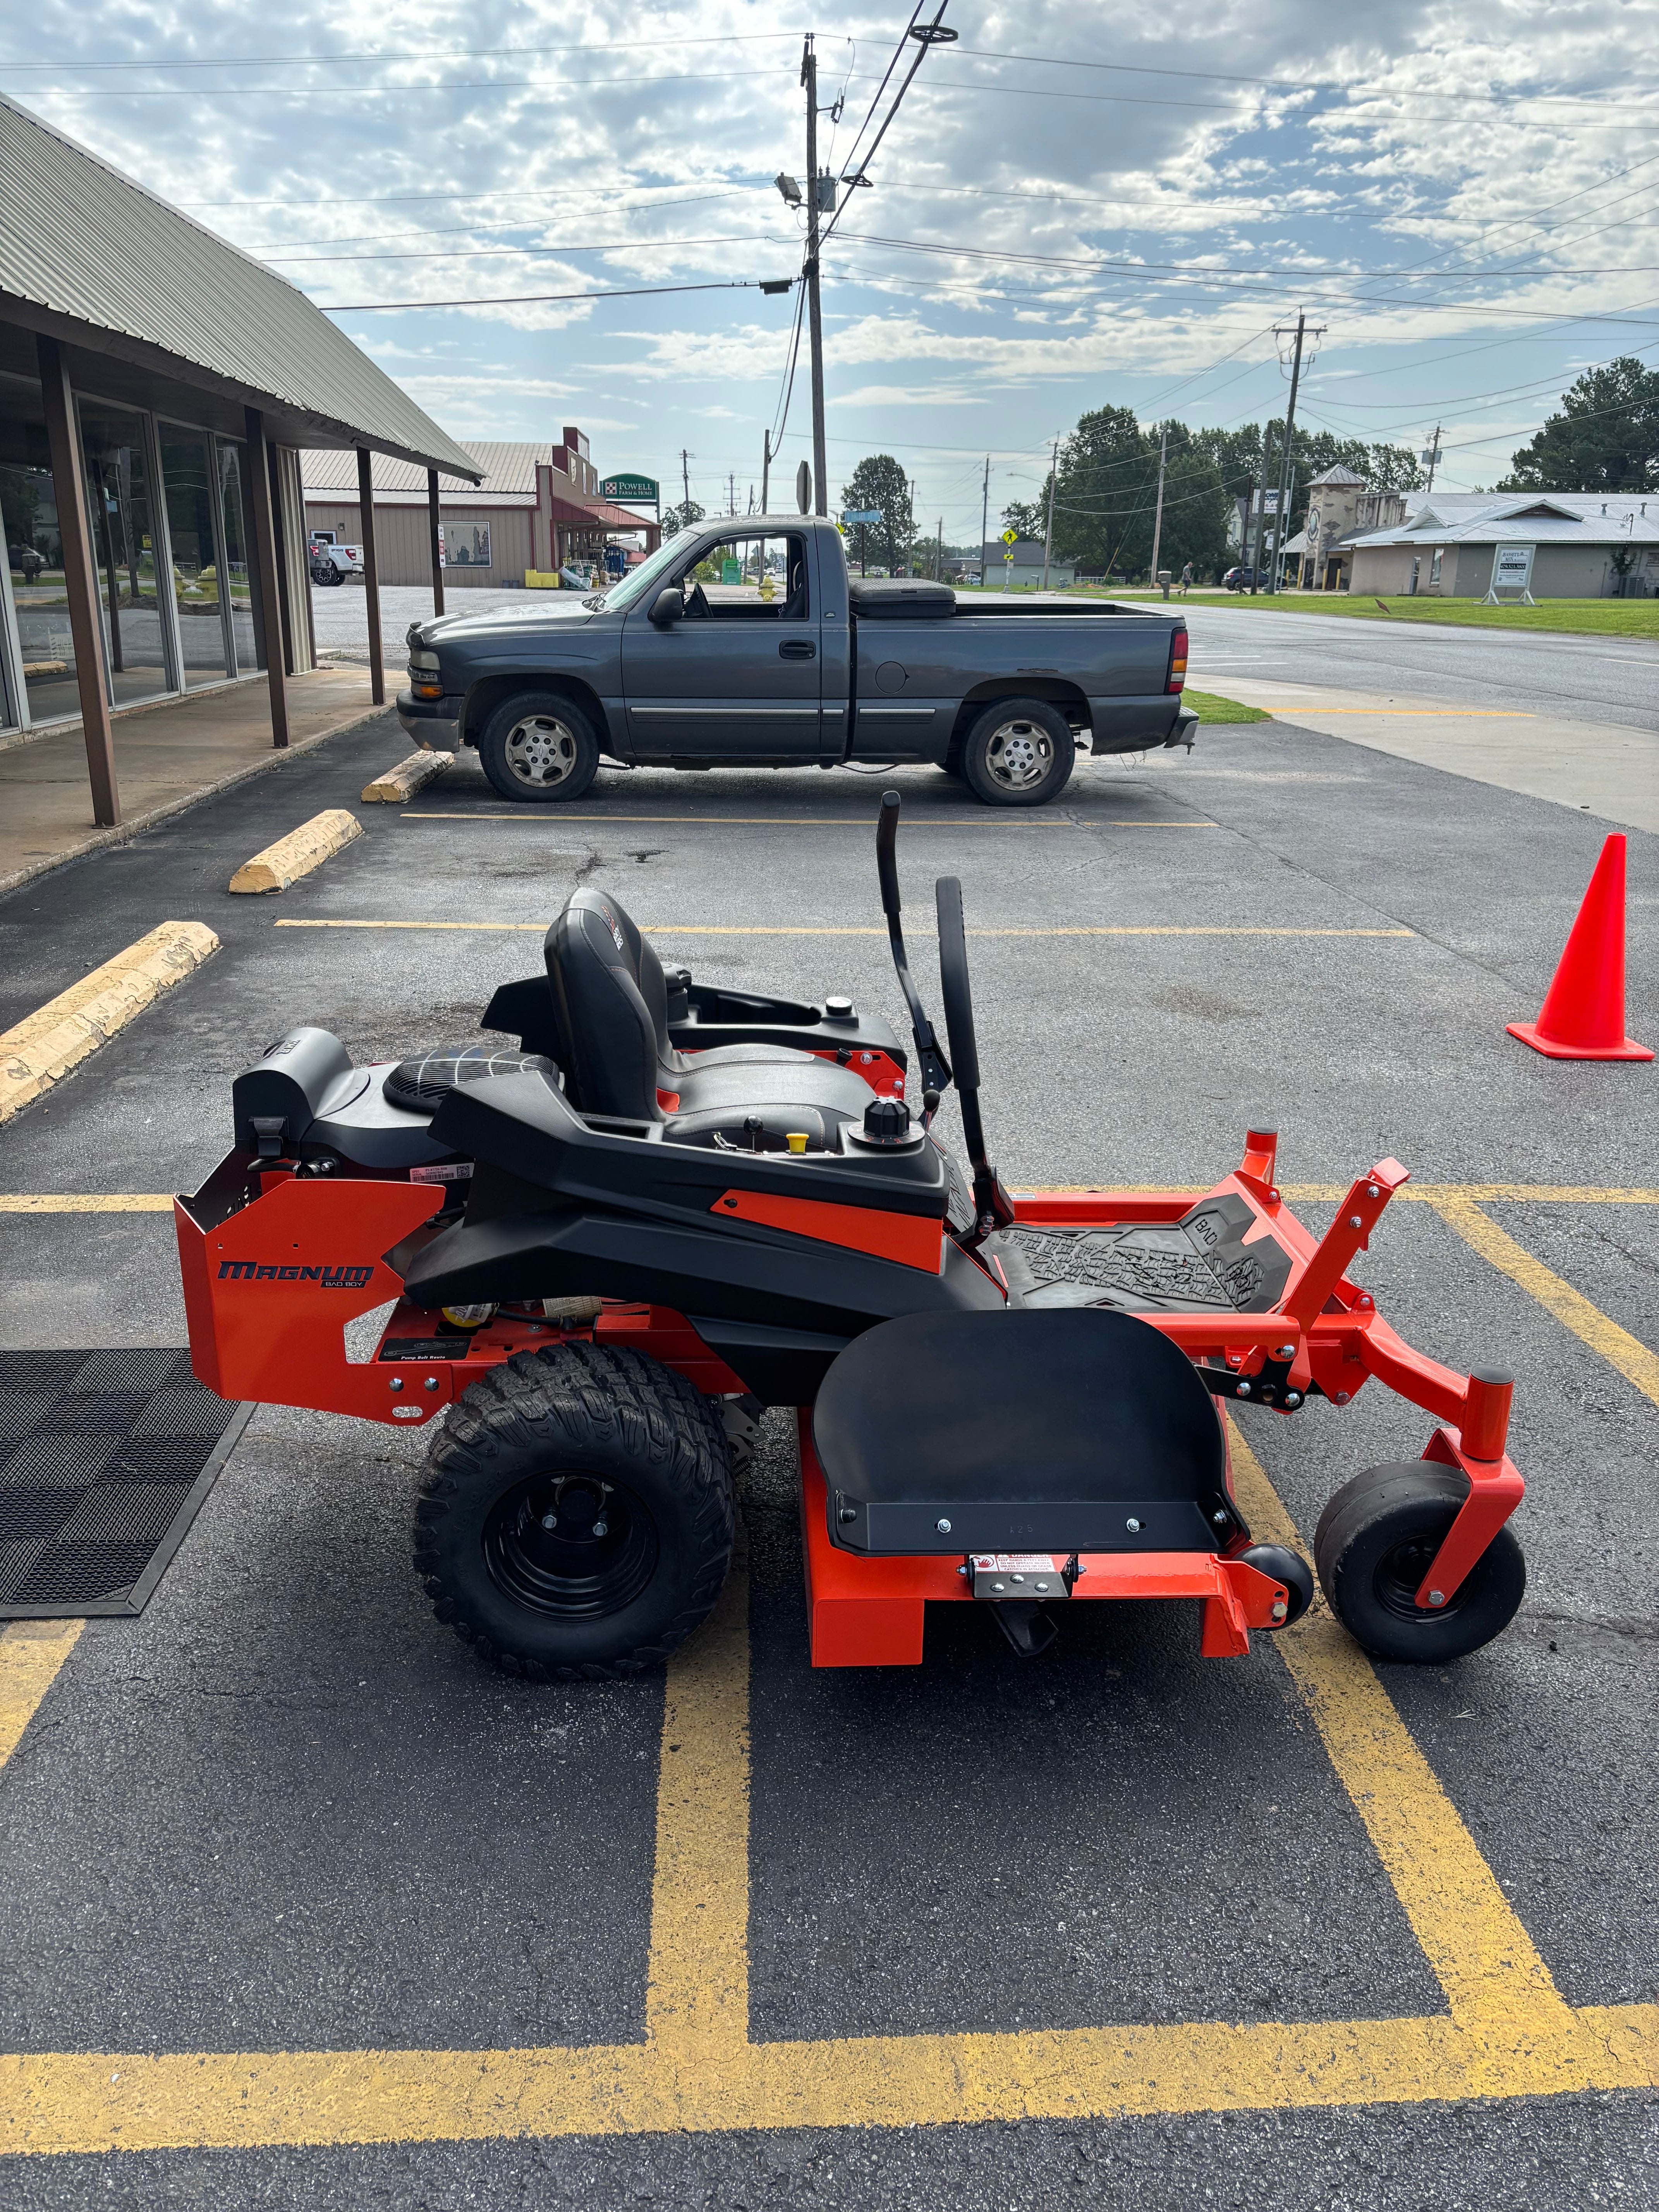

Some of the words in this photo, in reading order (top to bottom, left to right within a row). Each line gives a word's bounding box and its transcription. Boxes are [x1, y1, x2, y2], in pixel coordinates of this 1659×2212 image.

[619, 482, 652, 490] POWELL
[1195, 1219, 1218, 1245] BAD
[217, 1261, 375, 1280] MAGNUM
